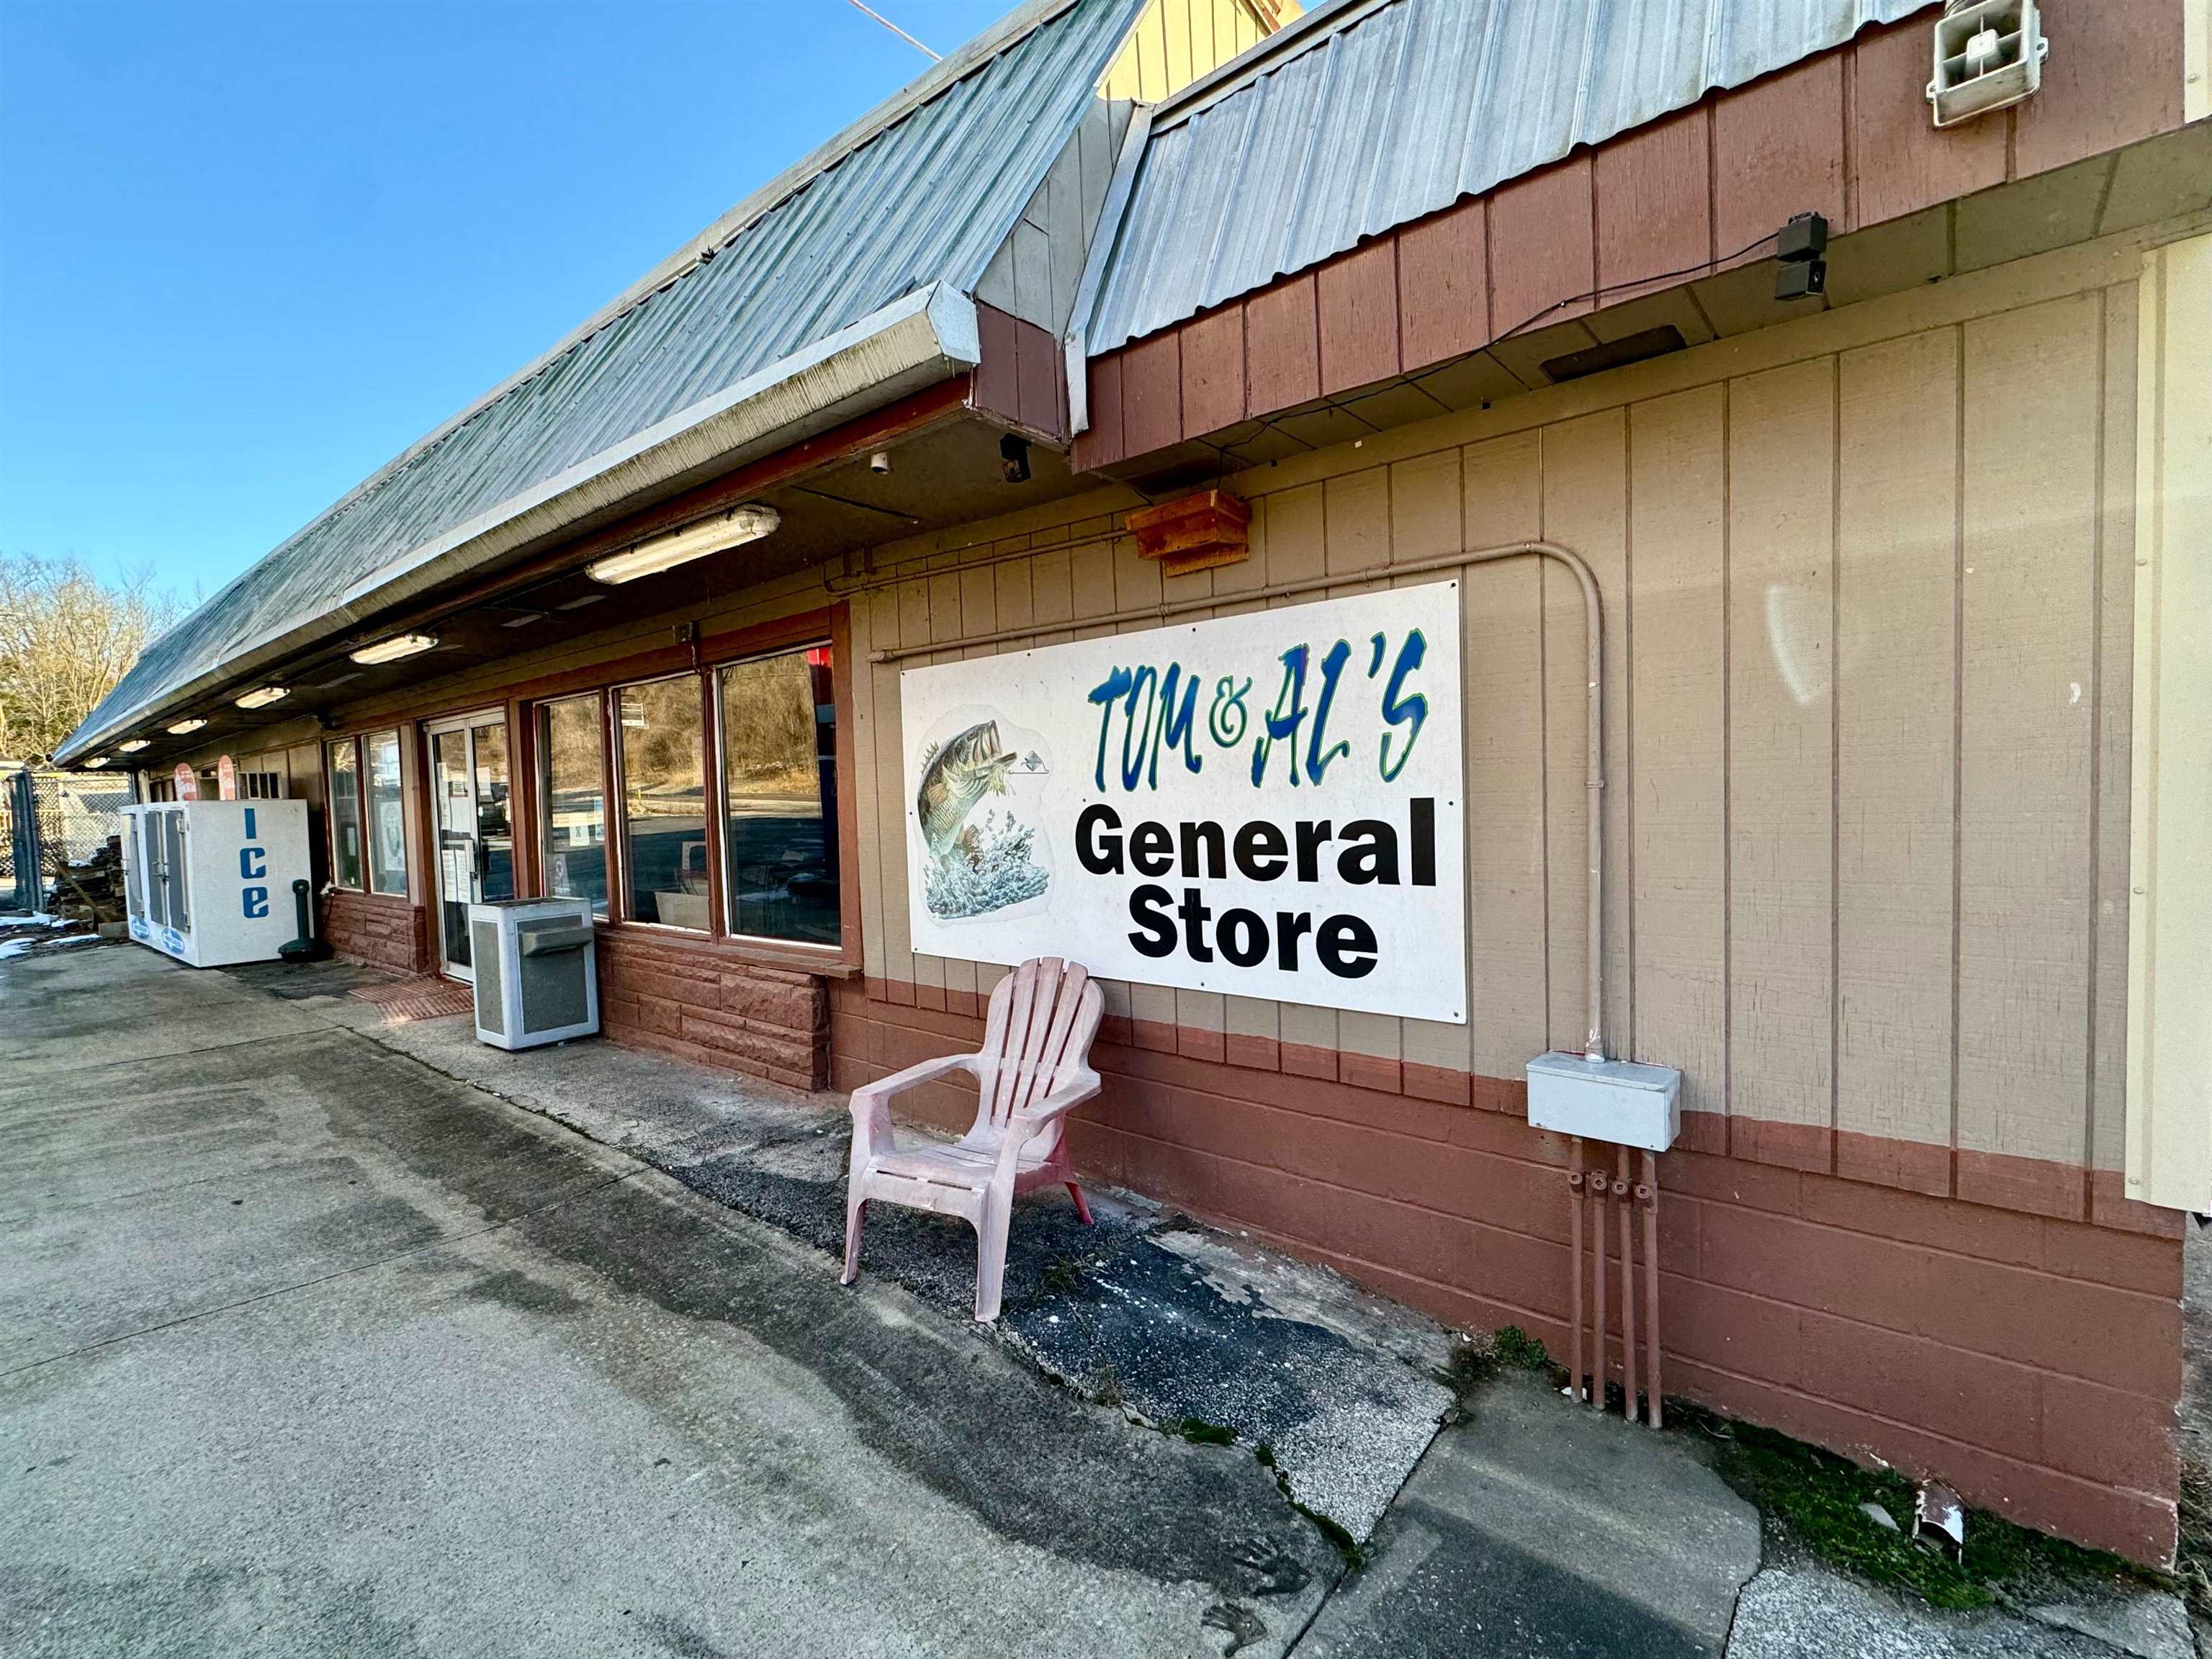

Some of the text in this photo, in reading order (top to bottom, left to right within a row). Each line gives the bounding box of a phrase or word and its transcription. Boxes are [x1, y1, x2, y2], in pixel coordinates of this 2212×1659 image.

[1088, 627, 1429, 792] TOM & AL'S
[1074, 797, 1437, 886] General
[1128, 886, 1379, 979] Store
